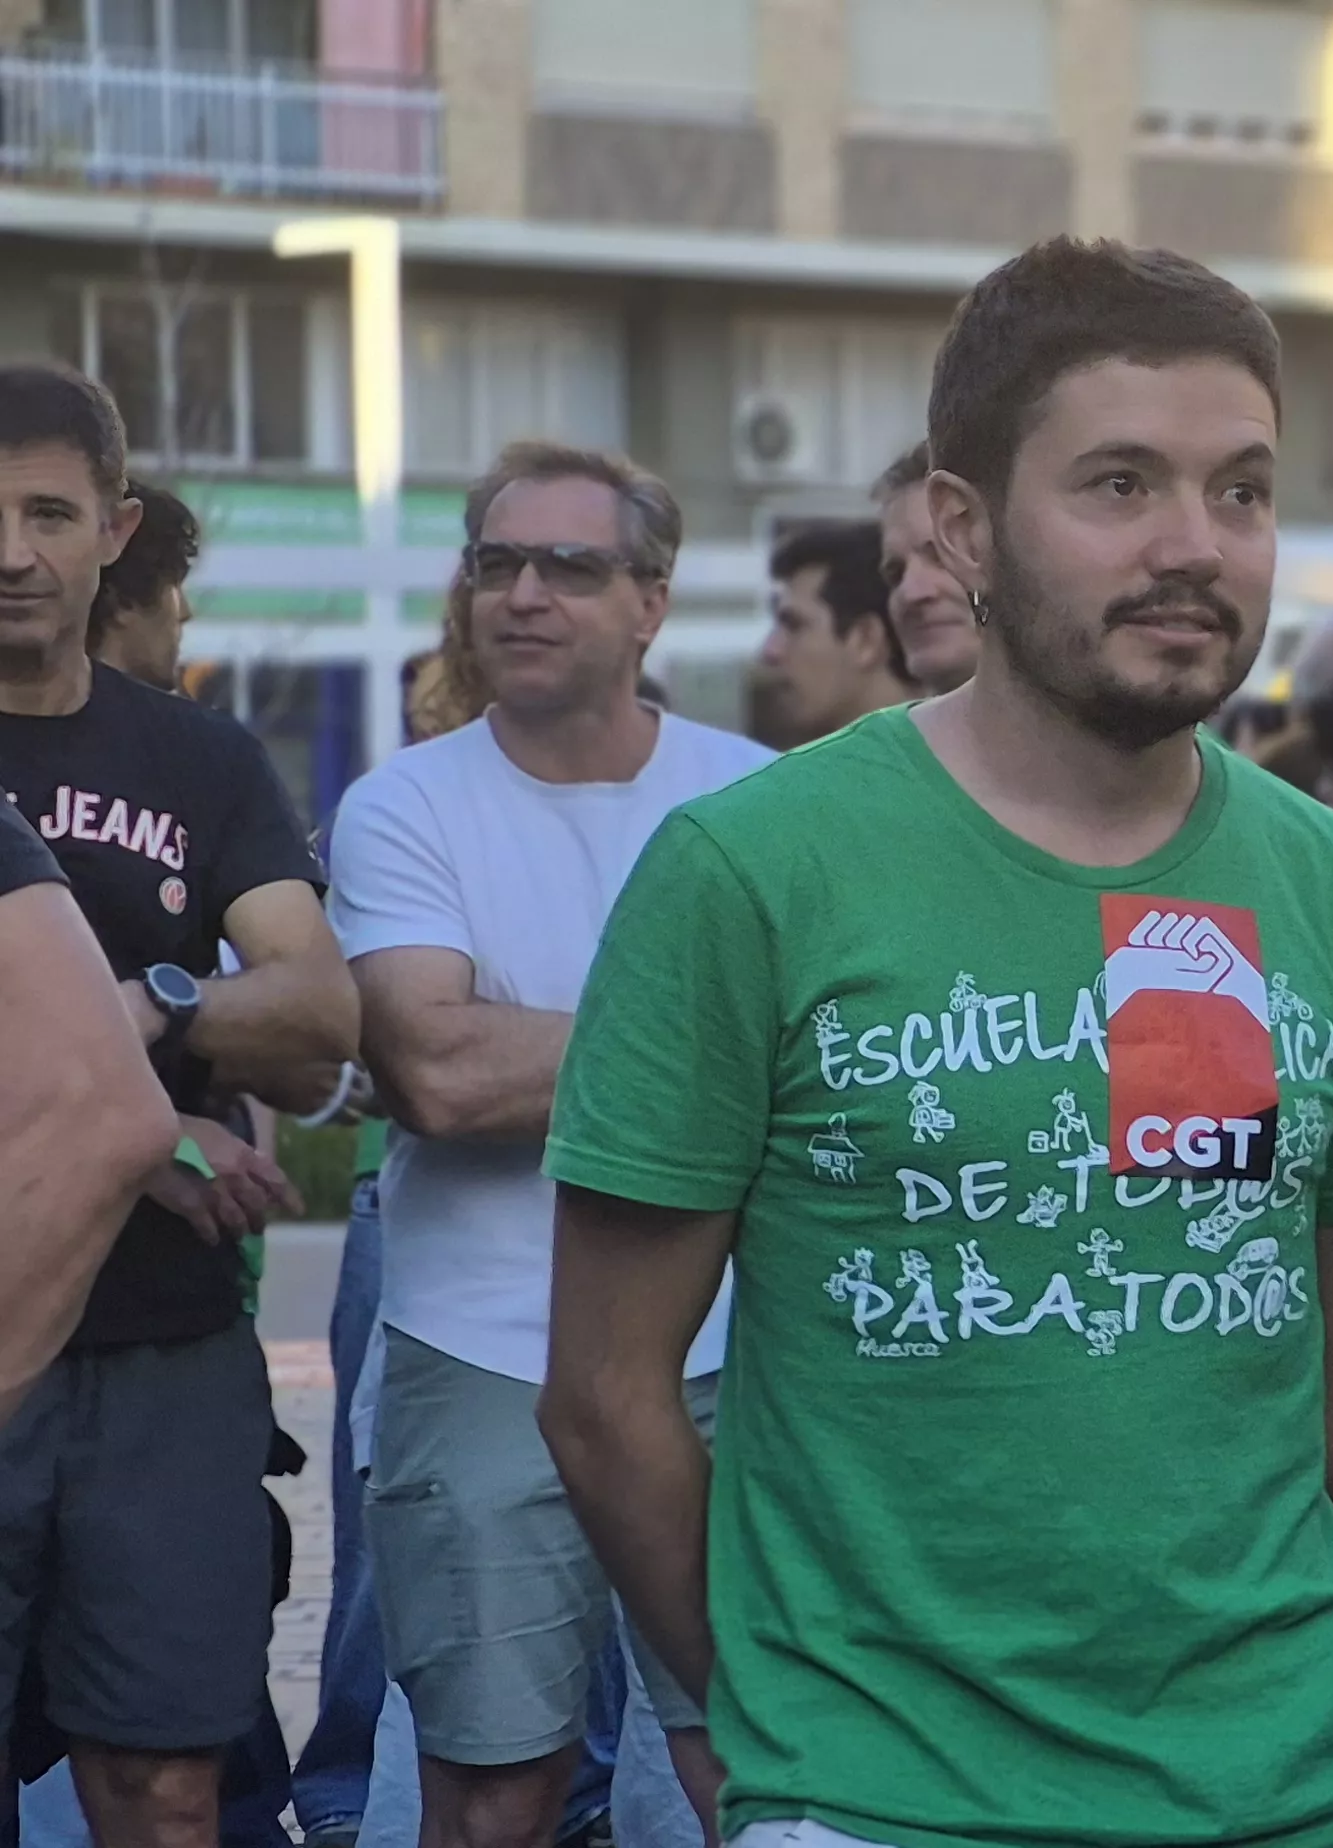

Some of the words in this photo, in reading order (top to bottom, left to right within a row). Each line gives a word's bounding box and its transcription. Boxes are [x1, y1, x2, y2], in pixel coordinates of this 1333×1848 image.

[40, 785, 189, 871] JEANS
[818, 988, 1109, 1090] ESCUELA
[1126, 1114, 1263, 1169] CGT
[896, 1160, 1008, 1223] DE
[848, 1272, 1087, 1342] PARA
[855, 1337, 943, 1357] Huesca
